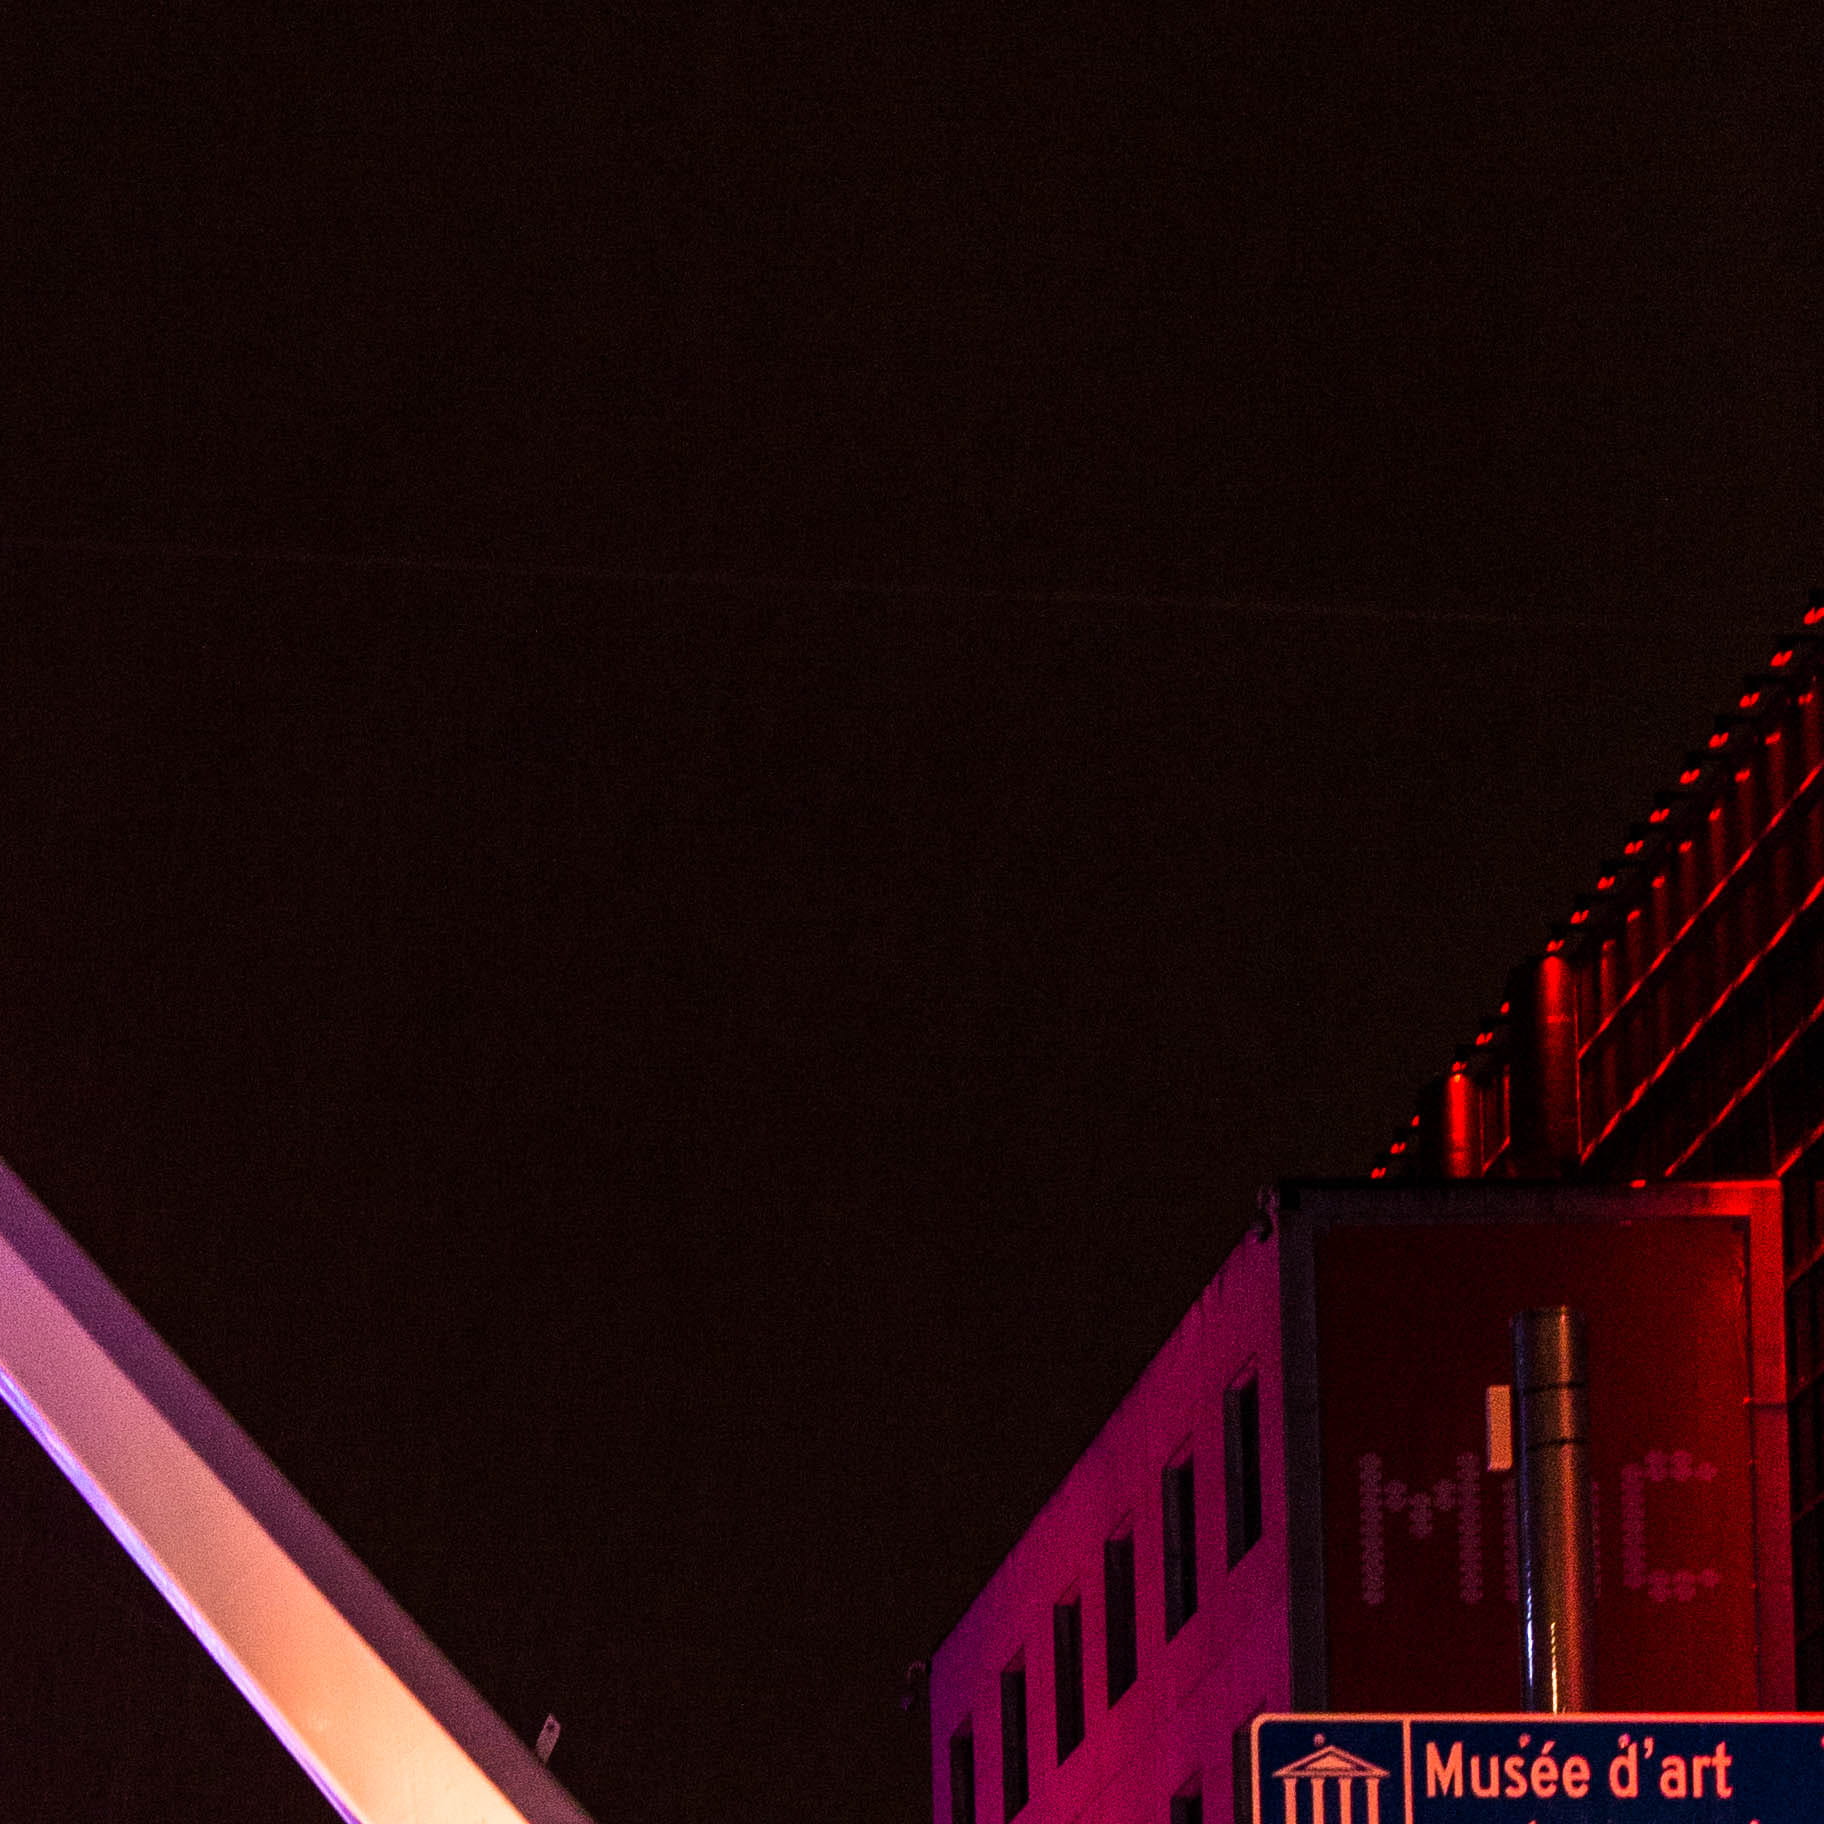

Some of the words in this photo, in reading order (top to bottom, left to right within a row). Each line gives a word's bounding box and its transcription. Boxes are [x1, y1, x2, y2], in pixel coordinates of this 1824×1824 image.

[1358, 1451, 1719, 1606] MC
[1425, 1740, 1590, 1799] Musée
[1608, 1737, 1734, 1799] d'art
